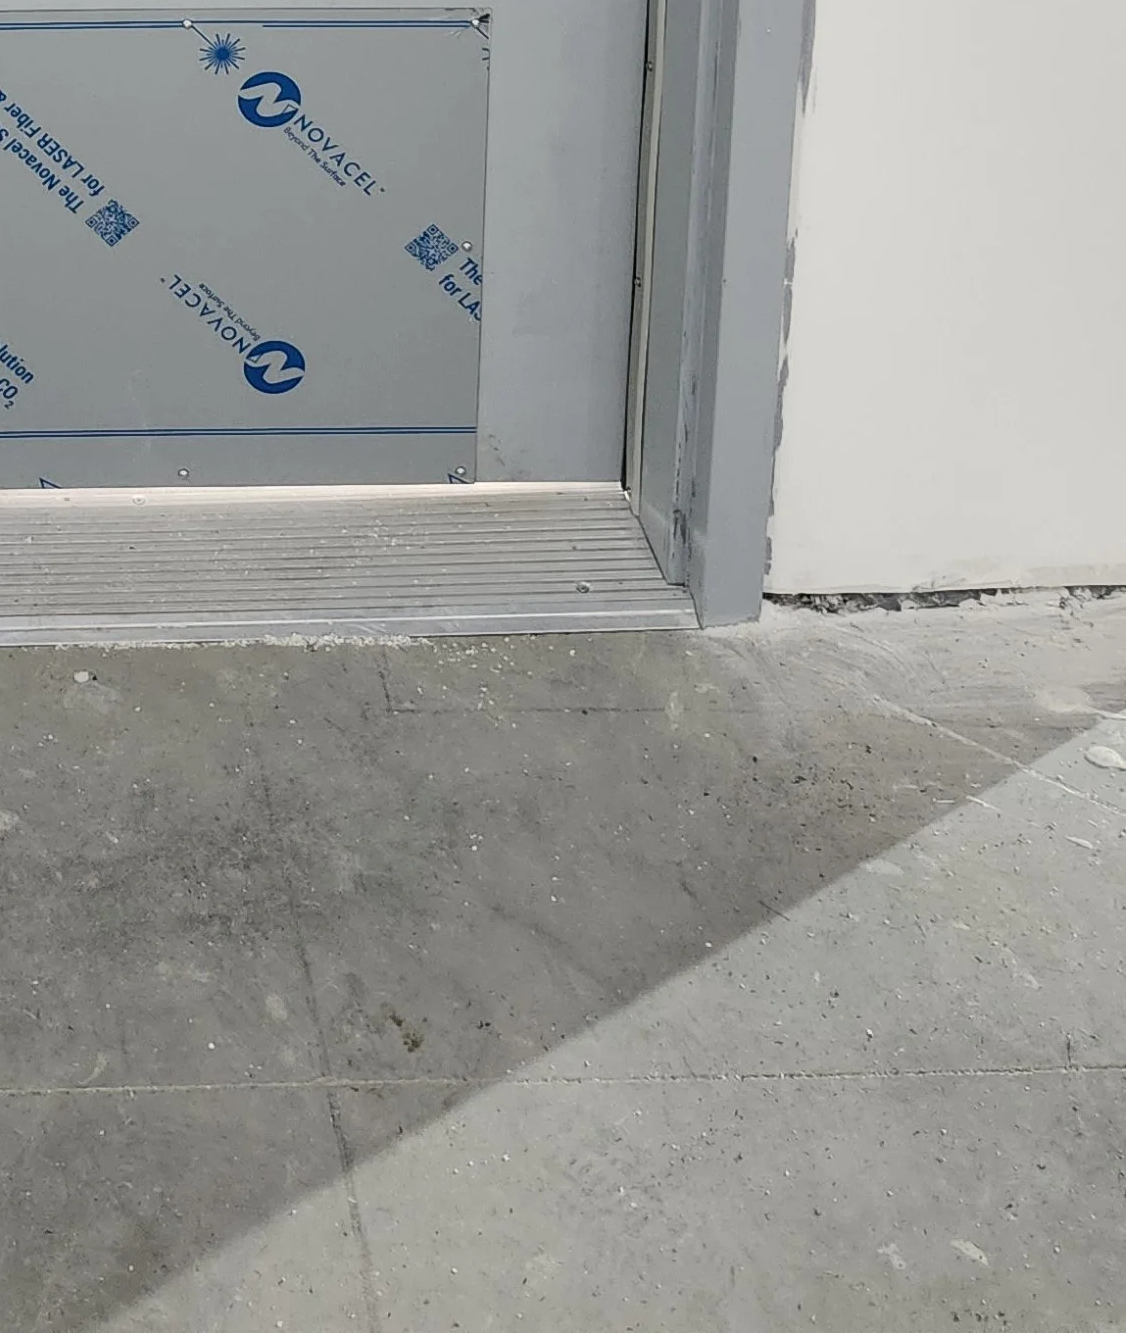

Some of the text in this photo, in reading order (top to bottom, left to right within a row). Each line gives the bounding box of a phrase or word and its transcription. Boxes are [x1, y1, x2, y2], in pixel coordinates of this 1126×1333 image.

[4, 102, 42, 139] Fiber
[2, 138, 62, 191] Novacel
[36, 132, 85, 179] LASER
[283, 126, 347, 187] Beyond The Surface
[293, 114, 377, 196] NOVACEL
[58, 185, 84, 214] The
[80, 174, 106, 197] for
[438, 273, 463, 296] for
[458, 256, 482, 286] The
[168, 273, 252, 355] NOVACEL
